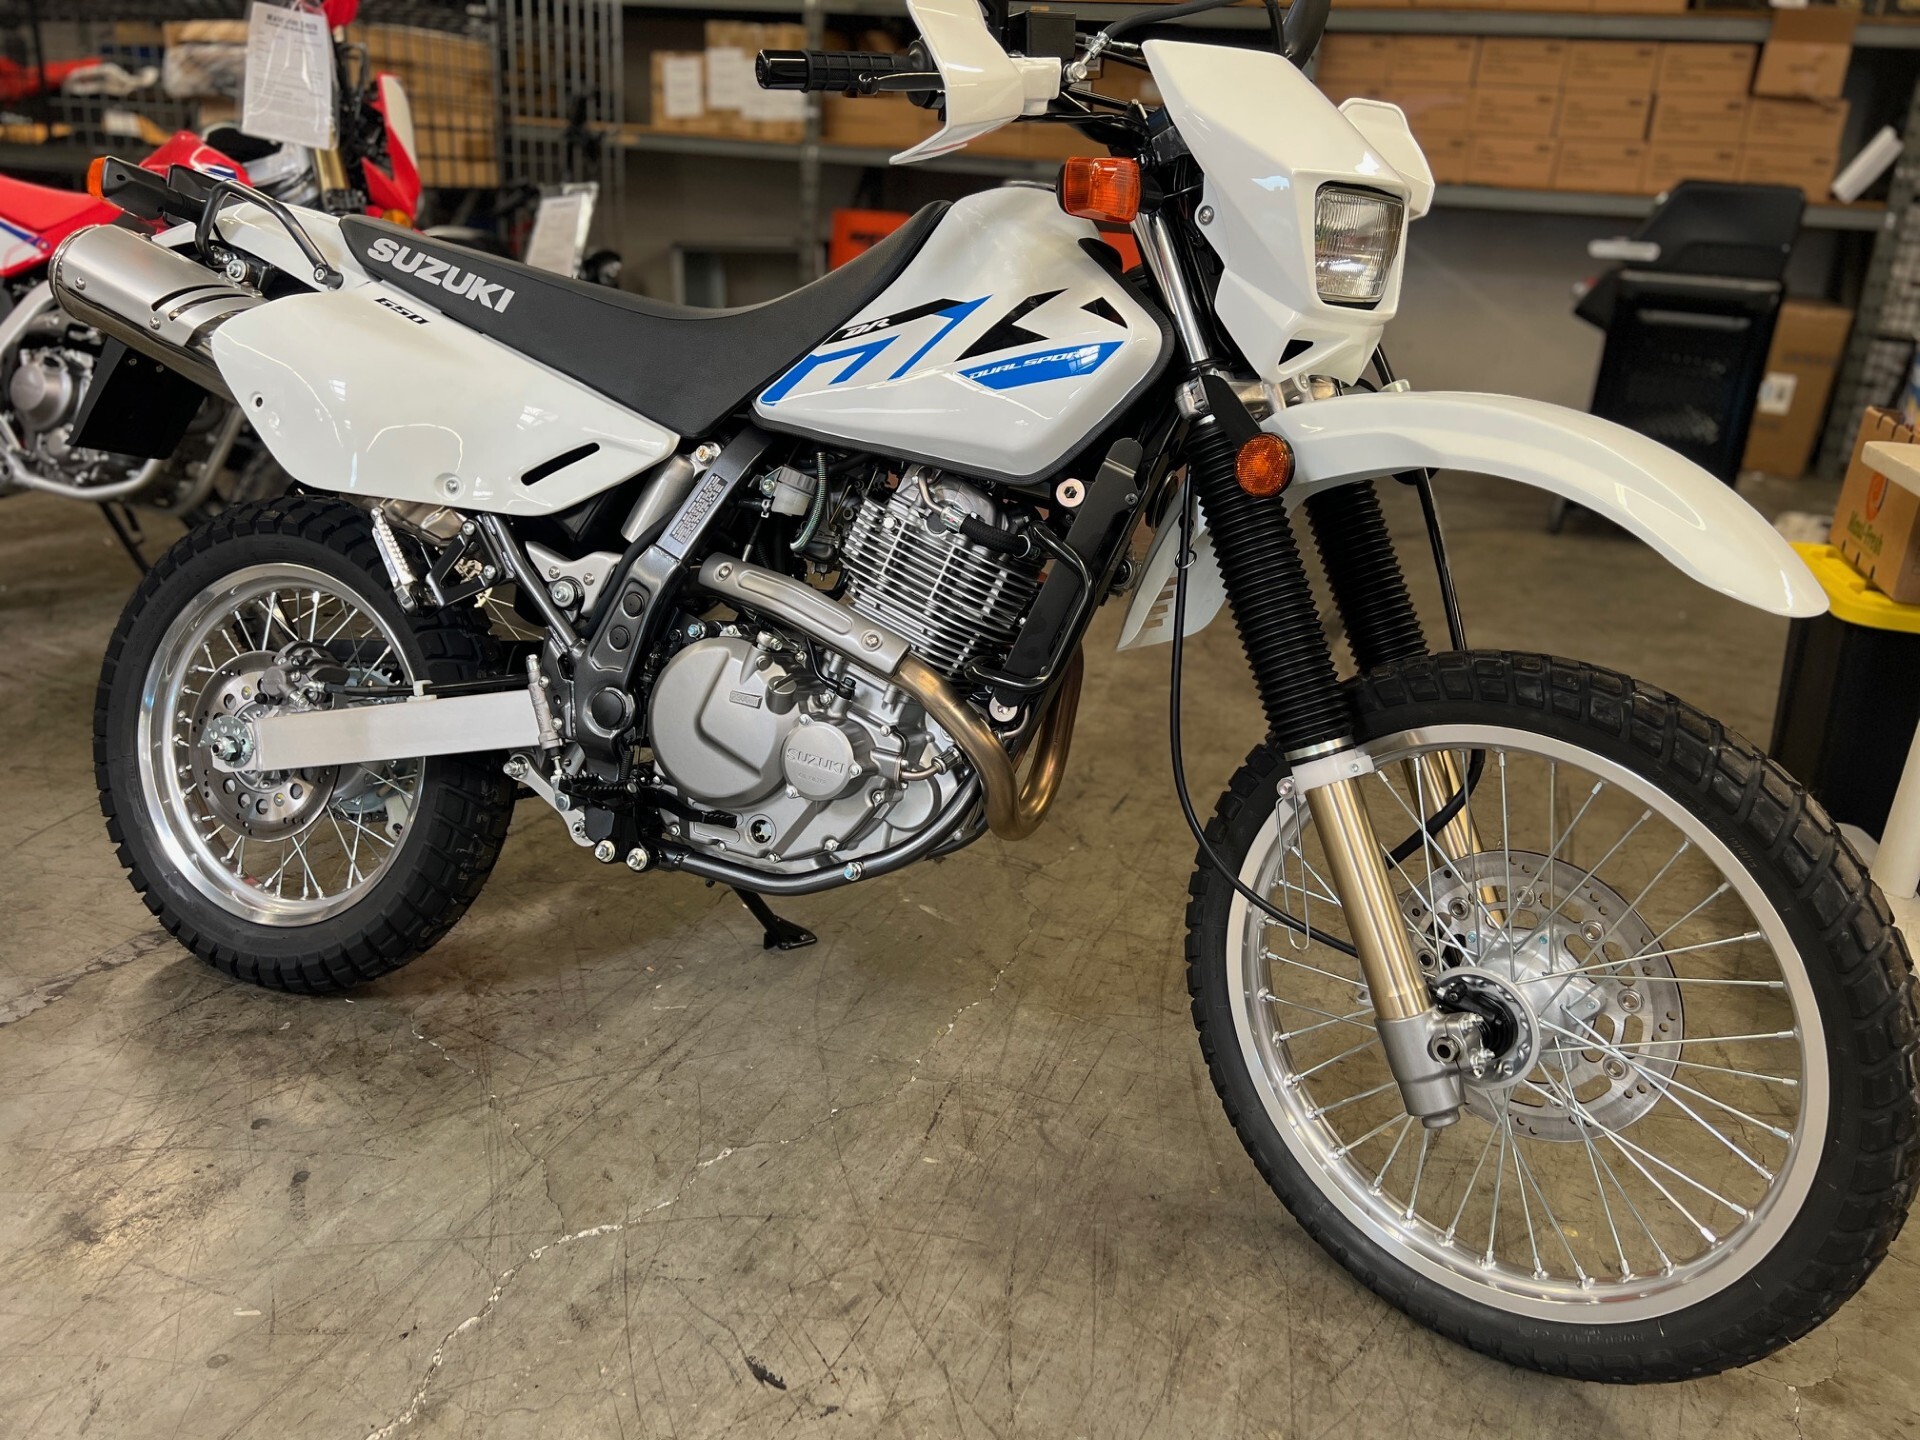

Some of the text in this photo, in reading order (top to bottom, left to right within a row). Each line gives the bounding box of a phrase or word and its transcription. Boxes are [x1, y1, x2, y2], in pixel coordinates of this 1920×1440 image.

[366, 237, 516, 314] SUZUKI
[374, 297, 430, 325] 650
[842, 318, 891, 338] DR
[968, 363, 1022, 381] DUAL
[786, 748, 845, 775] SUZUKI
